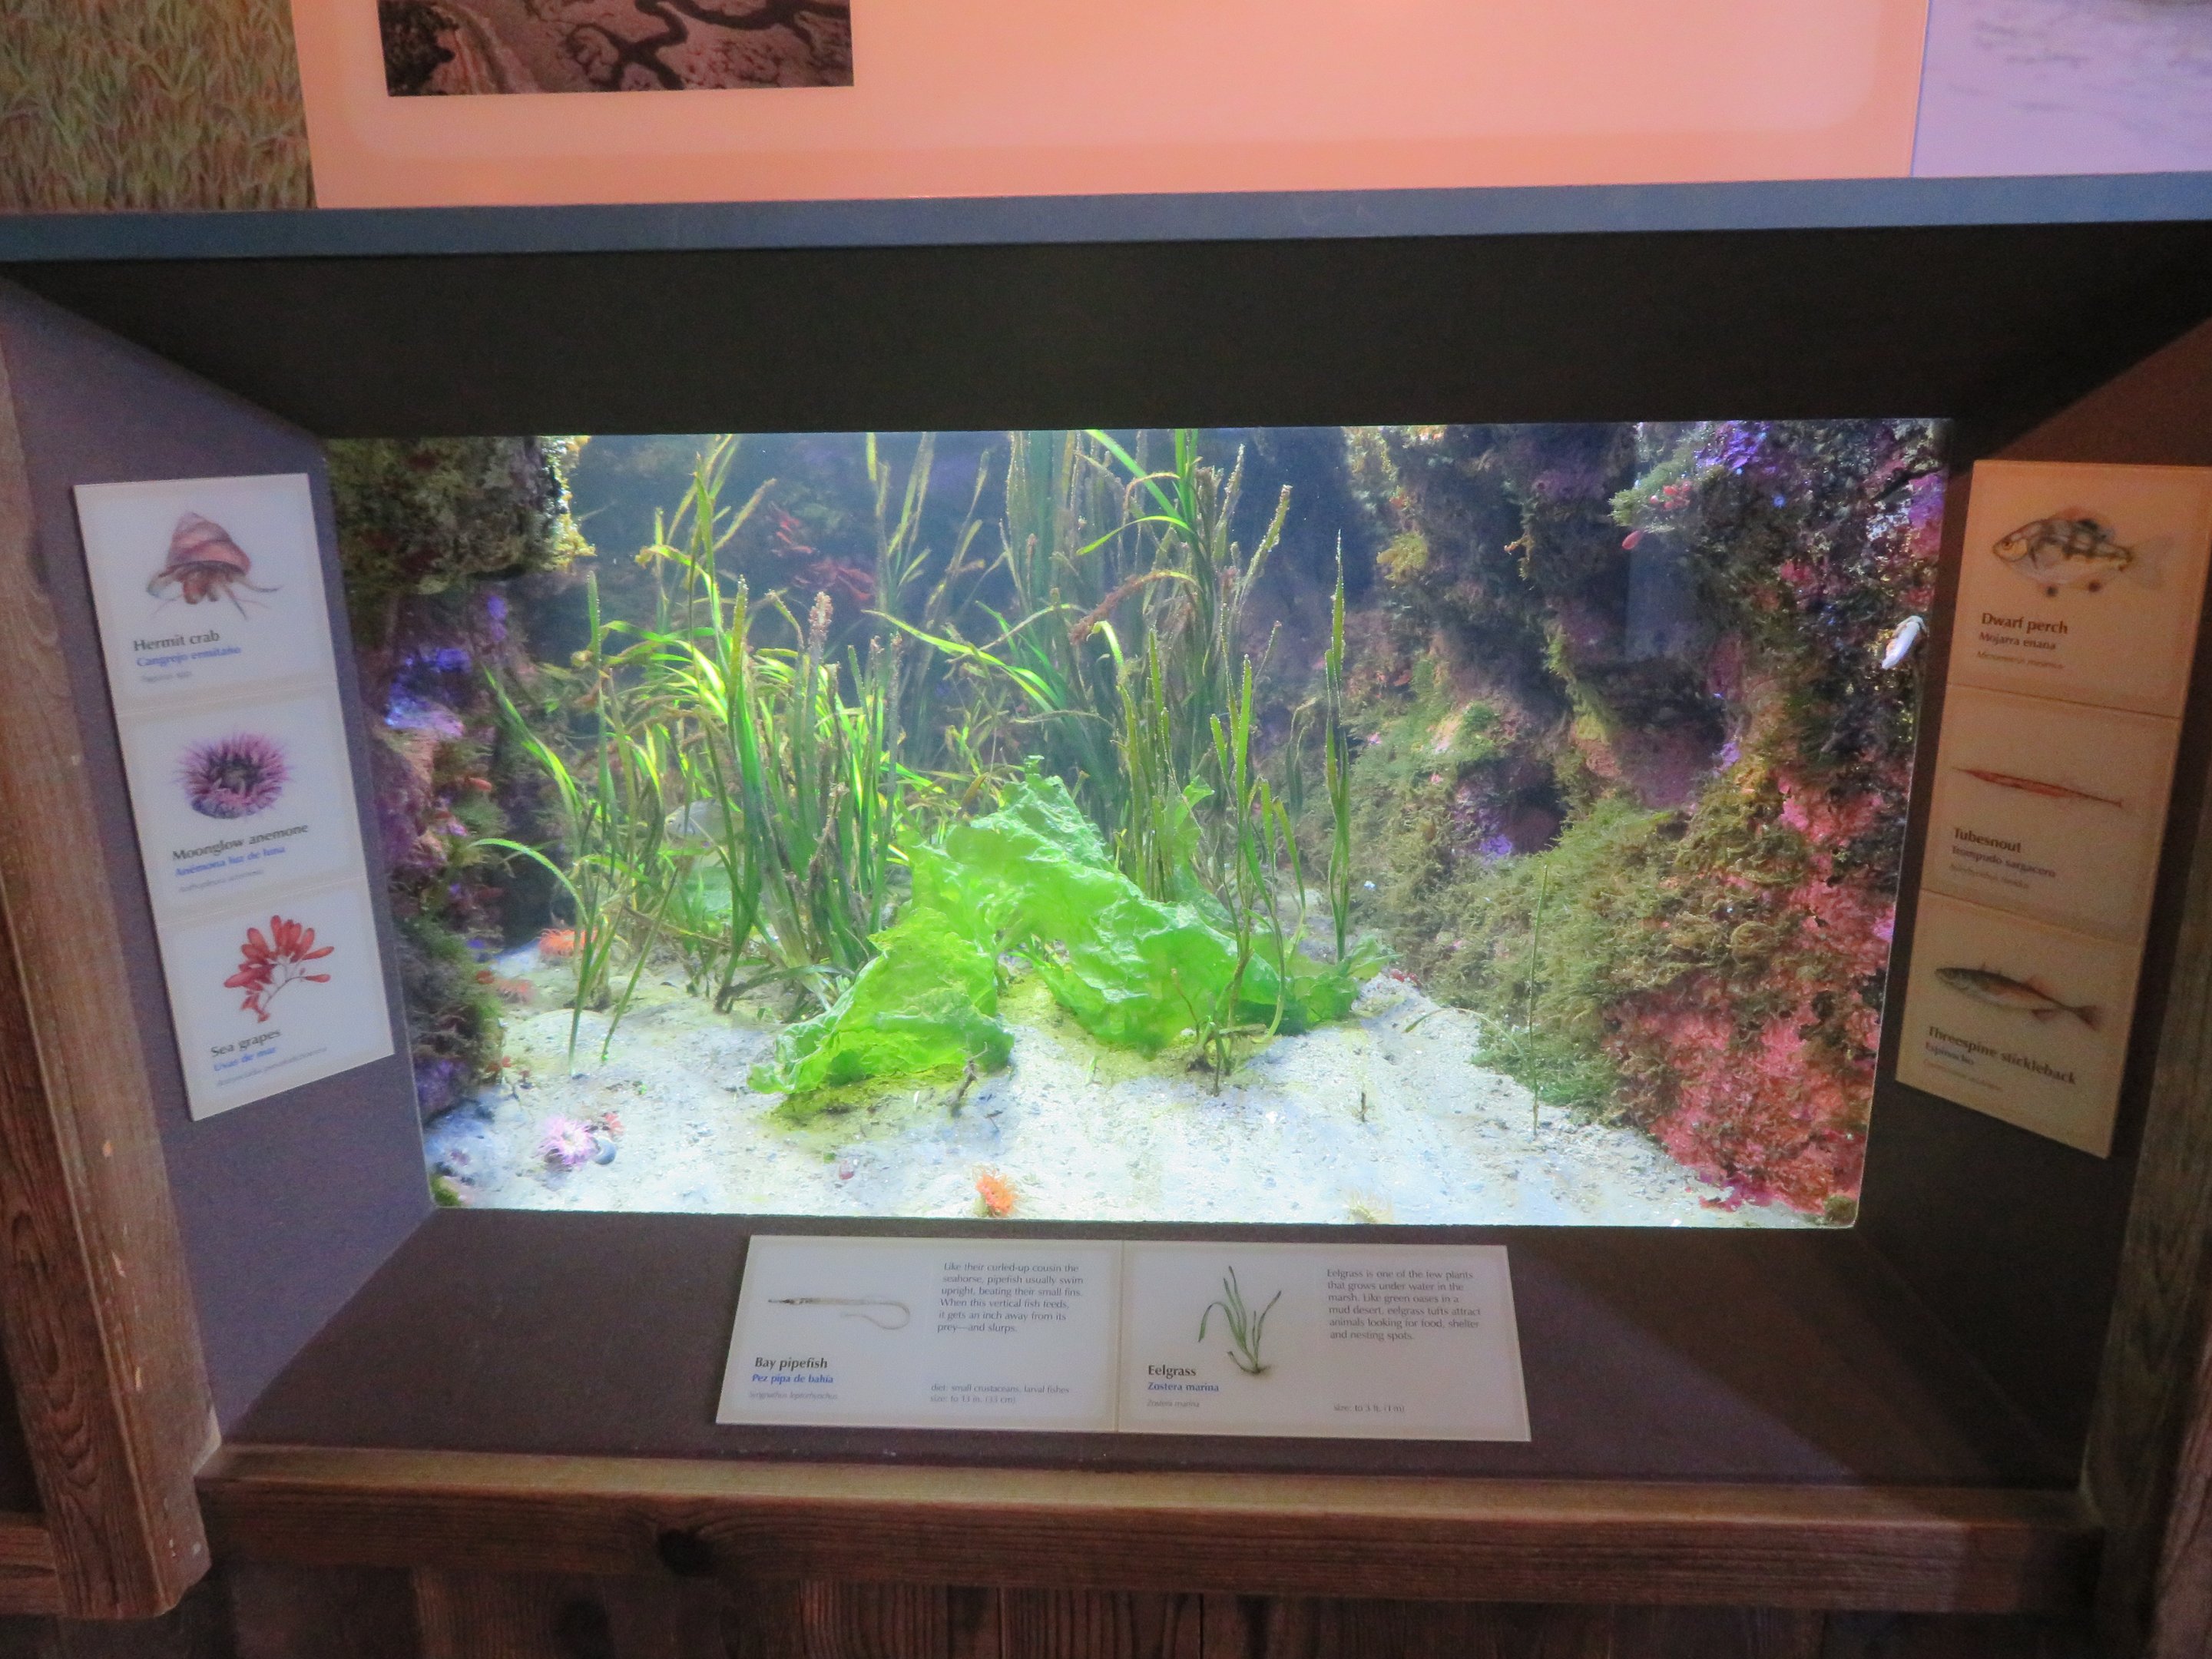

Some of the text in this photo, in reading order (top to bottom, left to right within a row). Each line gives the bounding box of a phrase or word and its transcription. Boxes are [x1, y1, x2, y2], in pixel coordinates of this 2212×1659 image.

[1982, 612, 2068, 634] Dwarf perch
[133, 630, 220, 651] Hermit crab
[1979, 632, 2020, 645] Mojarra
[173, 825, 308, 859] Moonglow anemone
[1954, 827, 2021, 853] Tubesnout
[211, 1030, 281, 1057] Sea grapes
[1929, 1026, 1998, 1057] Threespine
[2000, 1052, 2076, 1085] stickleback
[944, 1262, 961, 1272] Like
[964, 1262, 984, 1272] their
[987, 1263, 1029, 1273] curled-up
[1065, 1263, 1079, 1272] the
[942, 1274, 984, 1283] seahorse,
[987, 1276, 1022, 1285] pipefish
[1025, 1276, 1055, 1285] usually
[1327, 1269, 1363, 1278] Eelgrass
[1366, 1270, 1373, 1278] is
[1396, 1270, 1405, 1278] of
[1409, 1270, 1422, 1278] the
[1445, 1270, 1473, 1280] plants
[941, 1286, 975, 1296] upright,
[979, 1286, 1012, 1297] beating
[1015, 1287, 1035, 1296] their
[1065, 1287, 1082, 1296] fins.
[1437, 1282, 1446, 1290] in
[1449, 1283, 1464, 1291] the
[970, 1298, 985, 1306] this
[989, 1299, 1021, 1307] vertical
[1024, 1299, 1040, 1308] fish
[1043, 1300, 1069, 1309] feeds,
[1328, 1293, 1360, 1302] marsh.
[1363, 1293, 1379, 1302] Like
[1384, 1296, 1409, 1304] green
[939, 1310, 945, 1319] it
[947, 1310, 966, 1320] gets
[982, 1311, 1002, 1320] inch
[1031, 1312, 1053, 1320] from
[1056, 1312, 1066, 1320] its
[1387, 1306, 1425, 1316] eelgrass
[1451, 1307, 1481, 1316] attract
[988, 1323, 1017, 1334] slurps.
[1330, 1318, 1365, 1326] animals
[1368, 1319, 1402, 1329] looking
[1421, 1320, 1445, 1329] food,
[1350, 1331, 1384, 1341] nesting
[1387, 1332, 1413, 1341] spots.
[755, 1356, 828, 1372] Bay pipefish
[1148, 1364, 1197, 1379] Eelgrass
[752, 1373, 768, 1382] Pez
[770, 1373, 790, 1385] pipa
[793, 1374, 805, 1382] de
[1024, 1385, 1045, 1393] larval
[1047, 1385, 1069, 1393] fishes
[1147, 1382, 1219, 1392] Zostera marina
